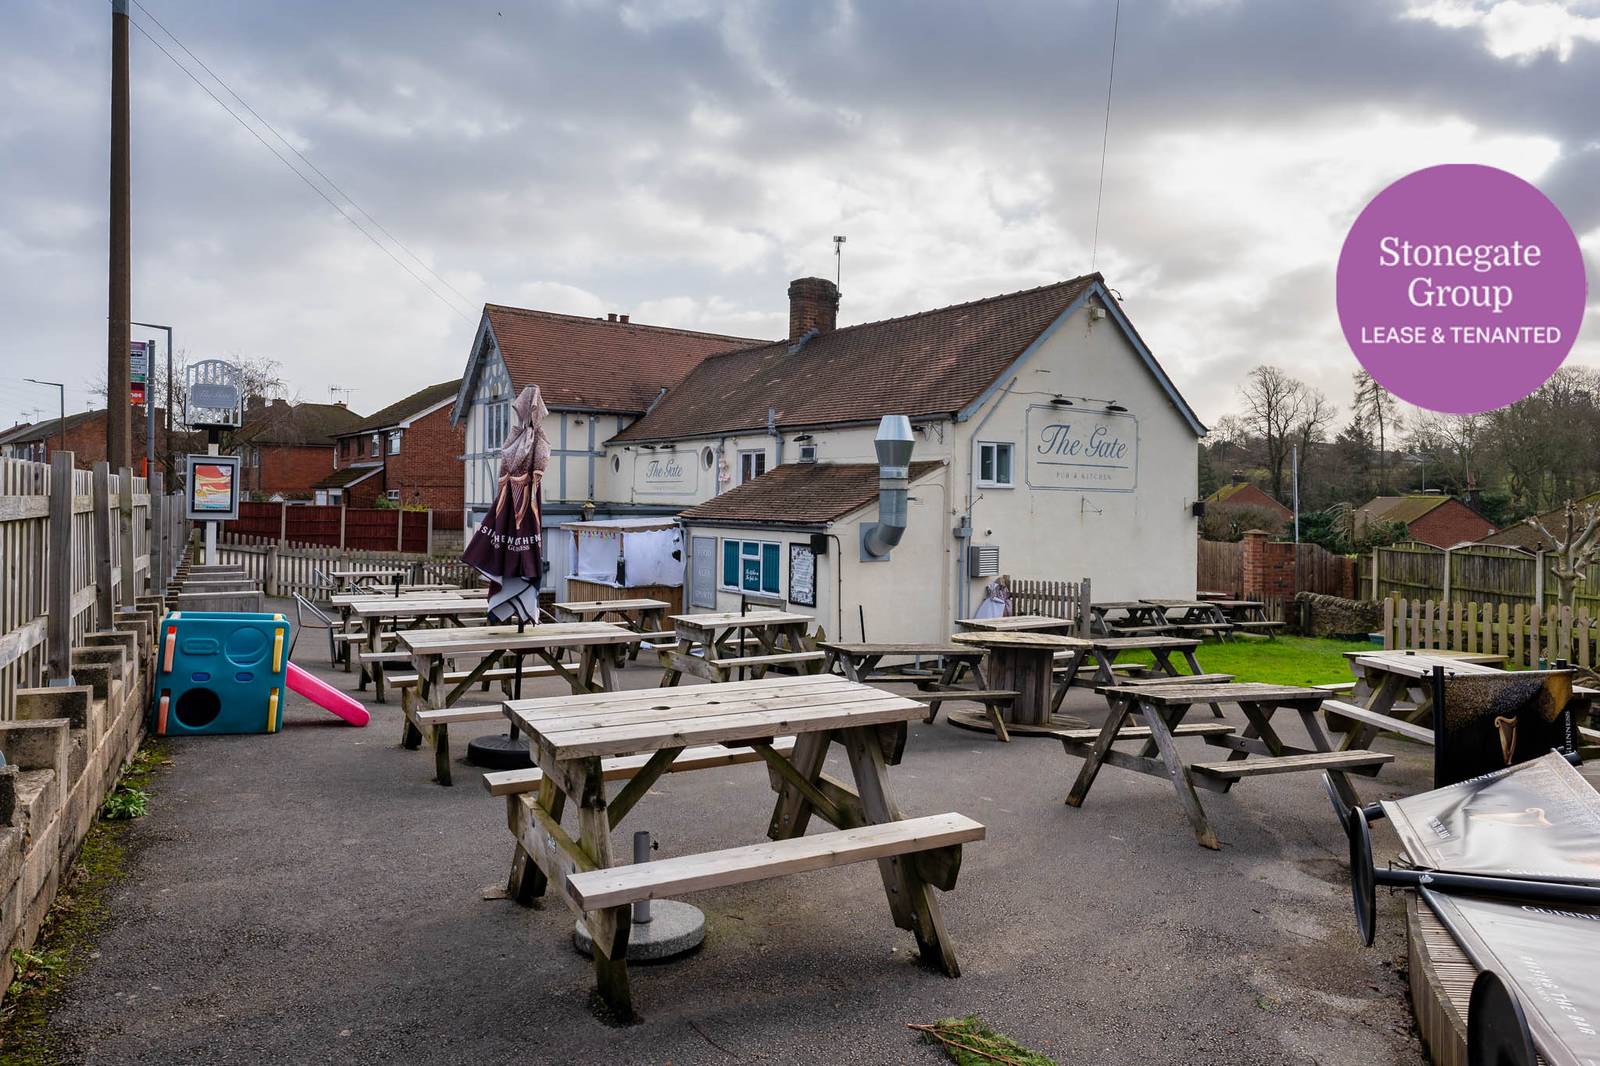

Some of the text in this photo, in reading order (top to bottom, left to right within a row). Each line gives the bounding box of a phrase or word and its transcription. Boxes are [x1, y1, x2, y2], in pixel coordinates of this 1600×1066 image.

[1037, 424, 1128, 459] The Gate
[646, 458, 684, 478] The Gate
